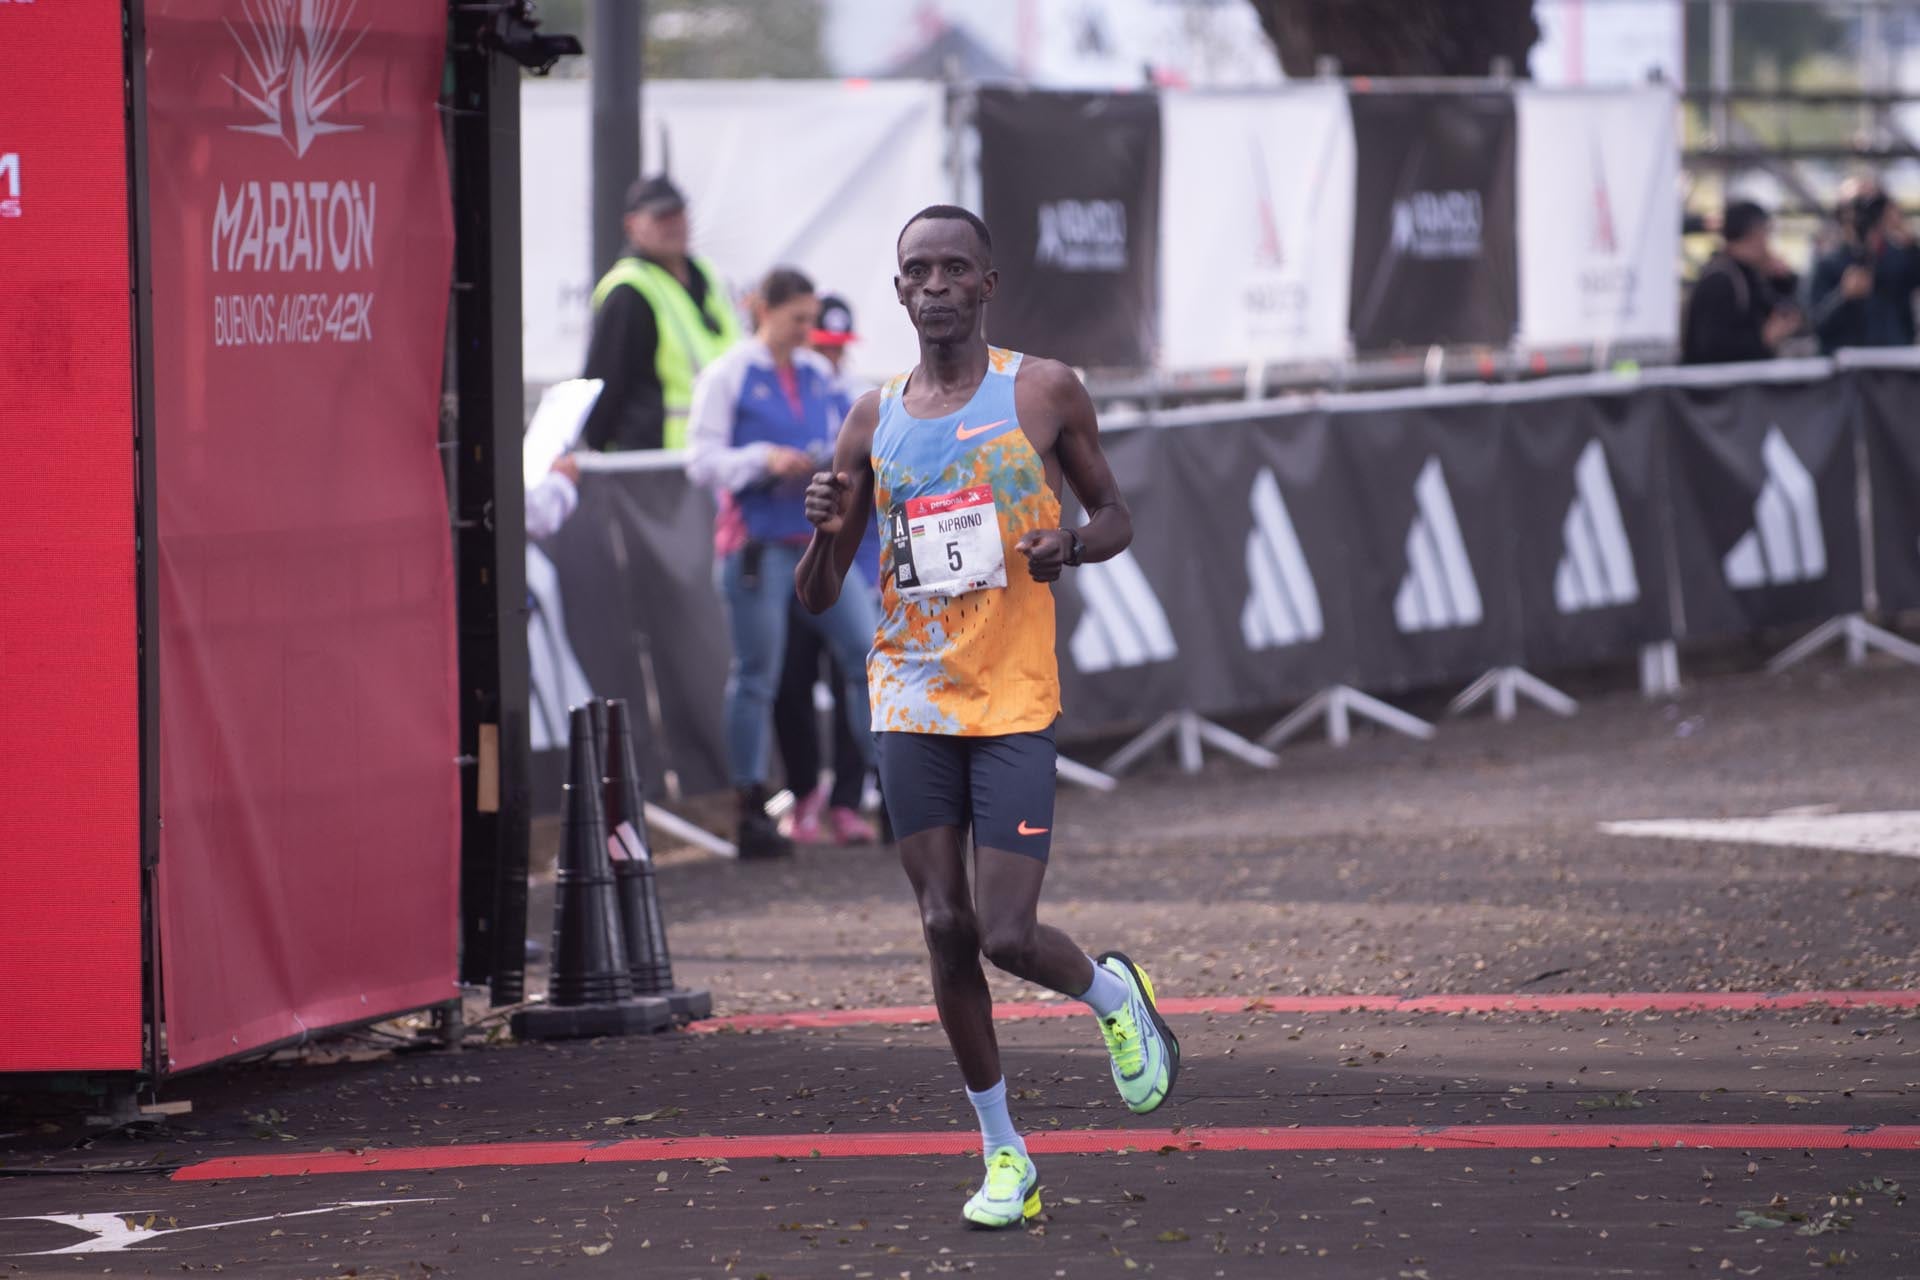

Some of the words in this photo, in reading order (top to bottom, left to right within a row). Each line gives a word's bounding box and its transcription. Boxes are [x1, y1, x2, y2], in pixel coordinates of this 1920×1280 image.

[211, 180, 376, 273] MARATON
[214, 293, 275, 346] BUENOS
[276, 293, 328, 343] AIRES
[325, 292, 374, 342] 42K
[896, 515, 904, 536] A
[938, 513, 982, 533] KIPRONO
[946, 541, 963, 571] 5
